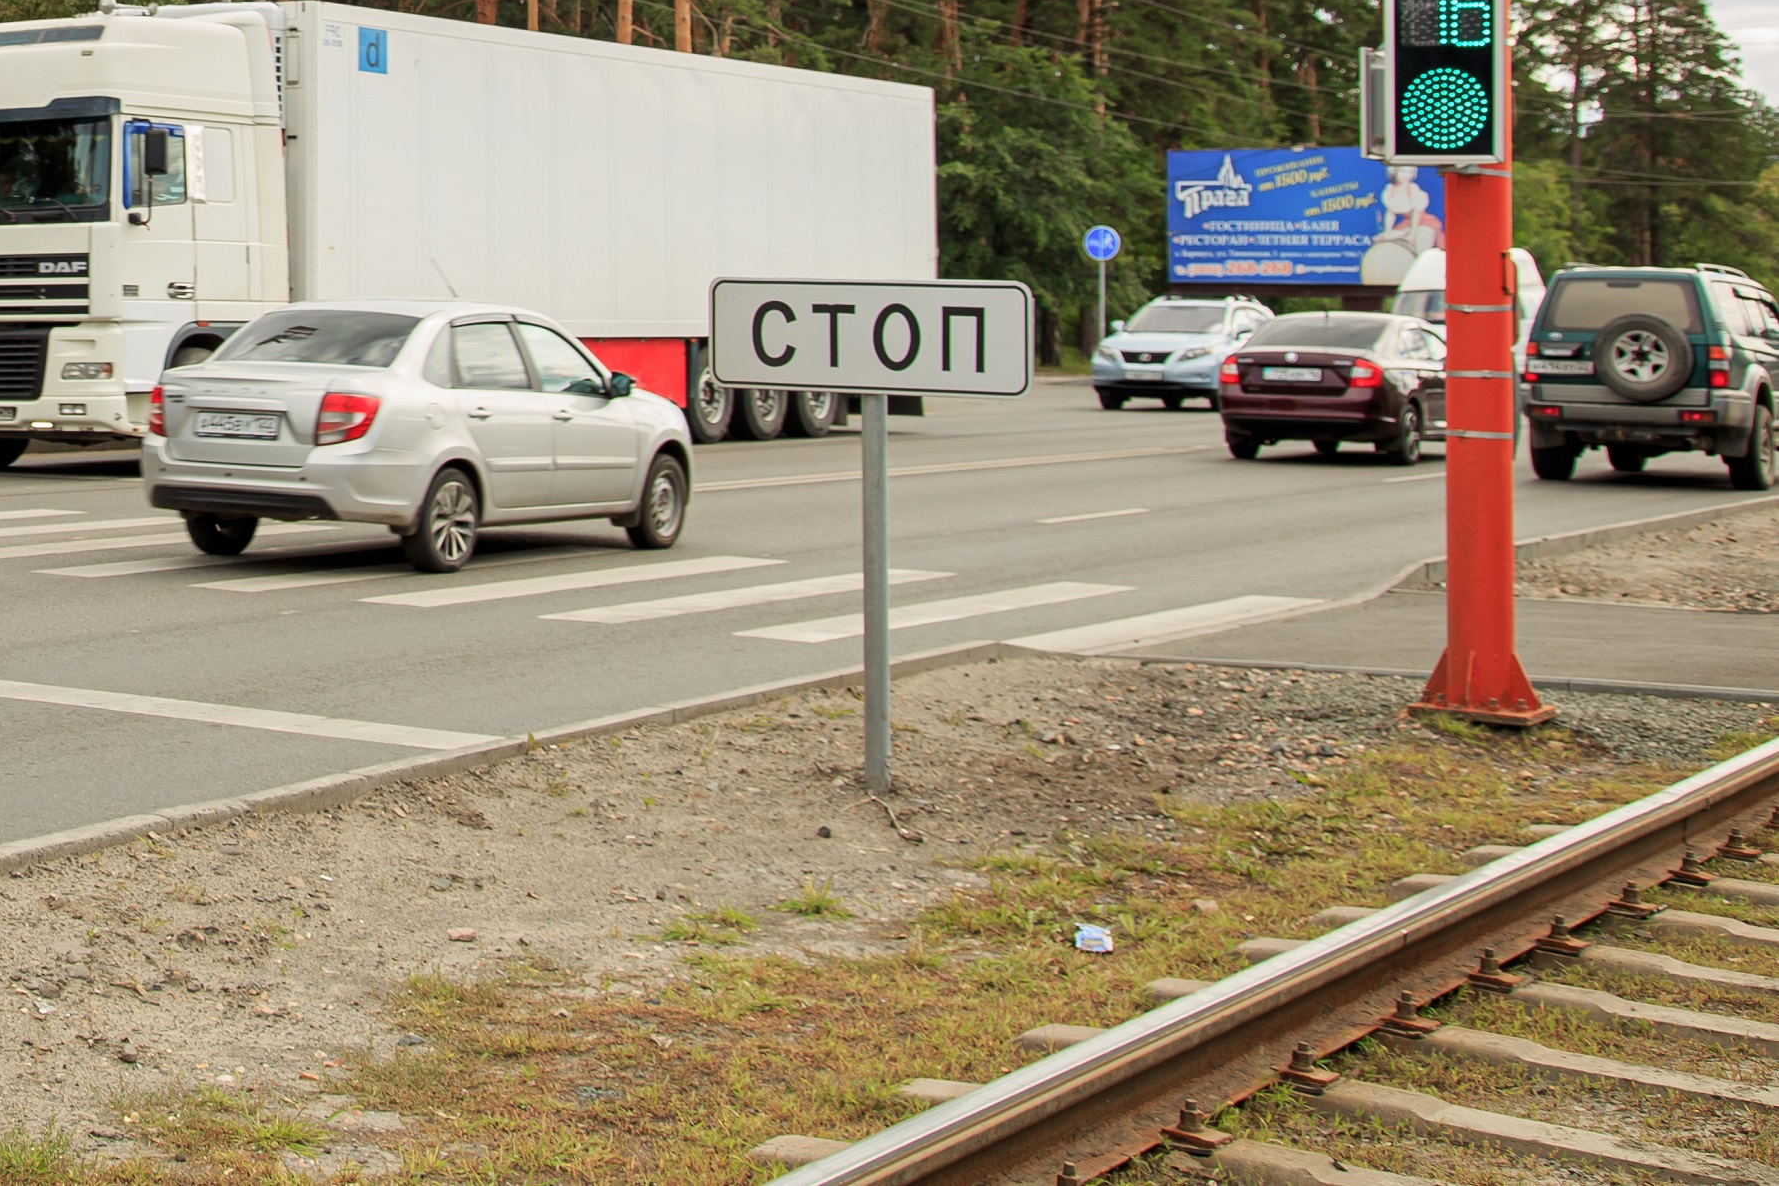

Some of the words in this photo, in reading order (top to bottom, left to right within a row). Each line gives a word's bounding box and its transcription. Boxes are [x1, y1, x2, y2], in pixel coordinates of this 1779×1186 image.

[366, 32, 380, 68] d
[1275, 169, 1308, 188] 1500
[1321, 194, 1354, 214] 1500
[39, 261, 87, 273] DAF
[752, 300, 986, 373] СТОП
